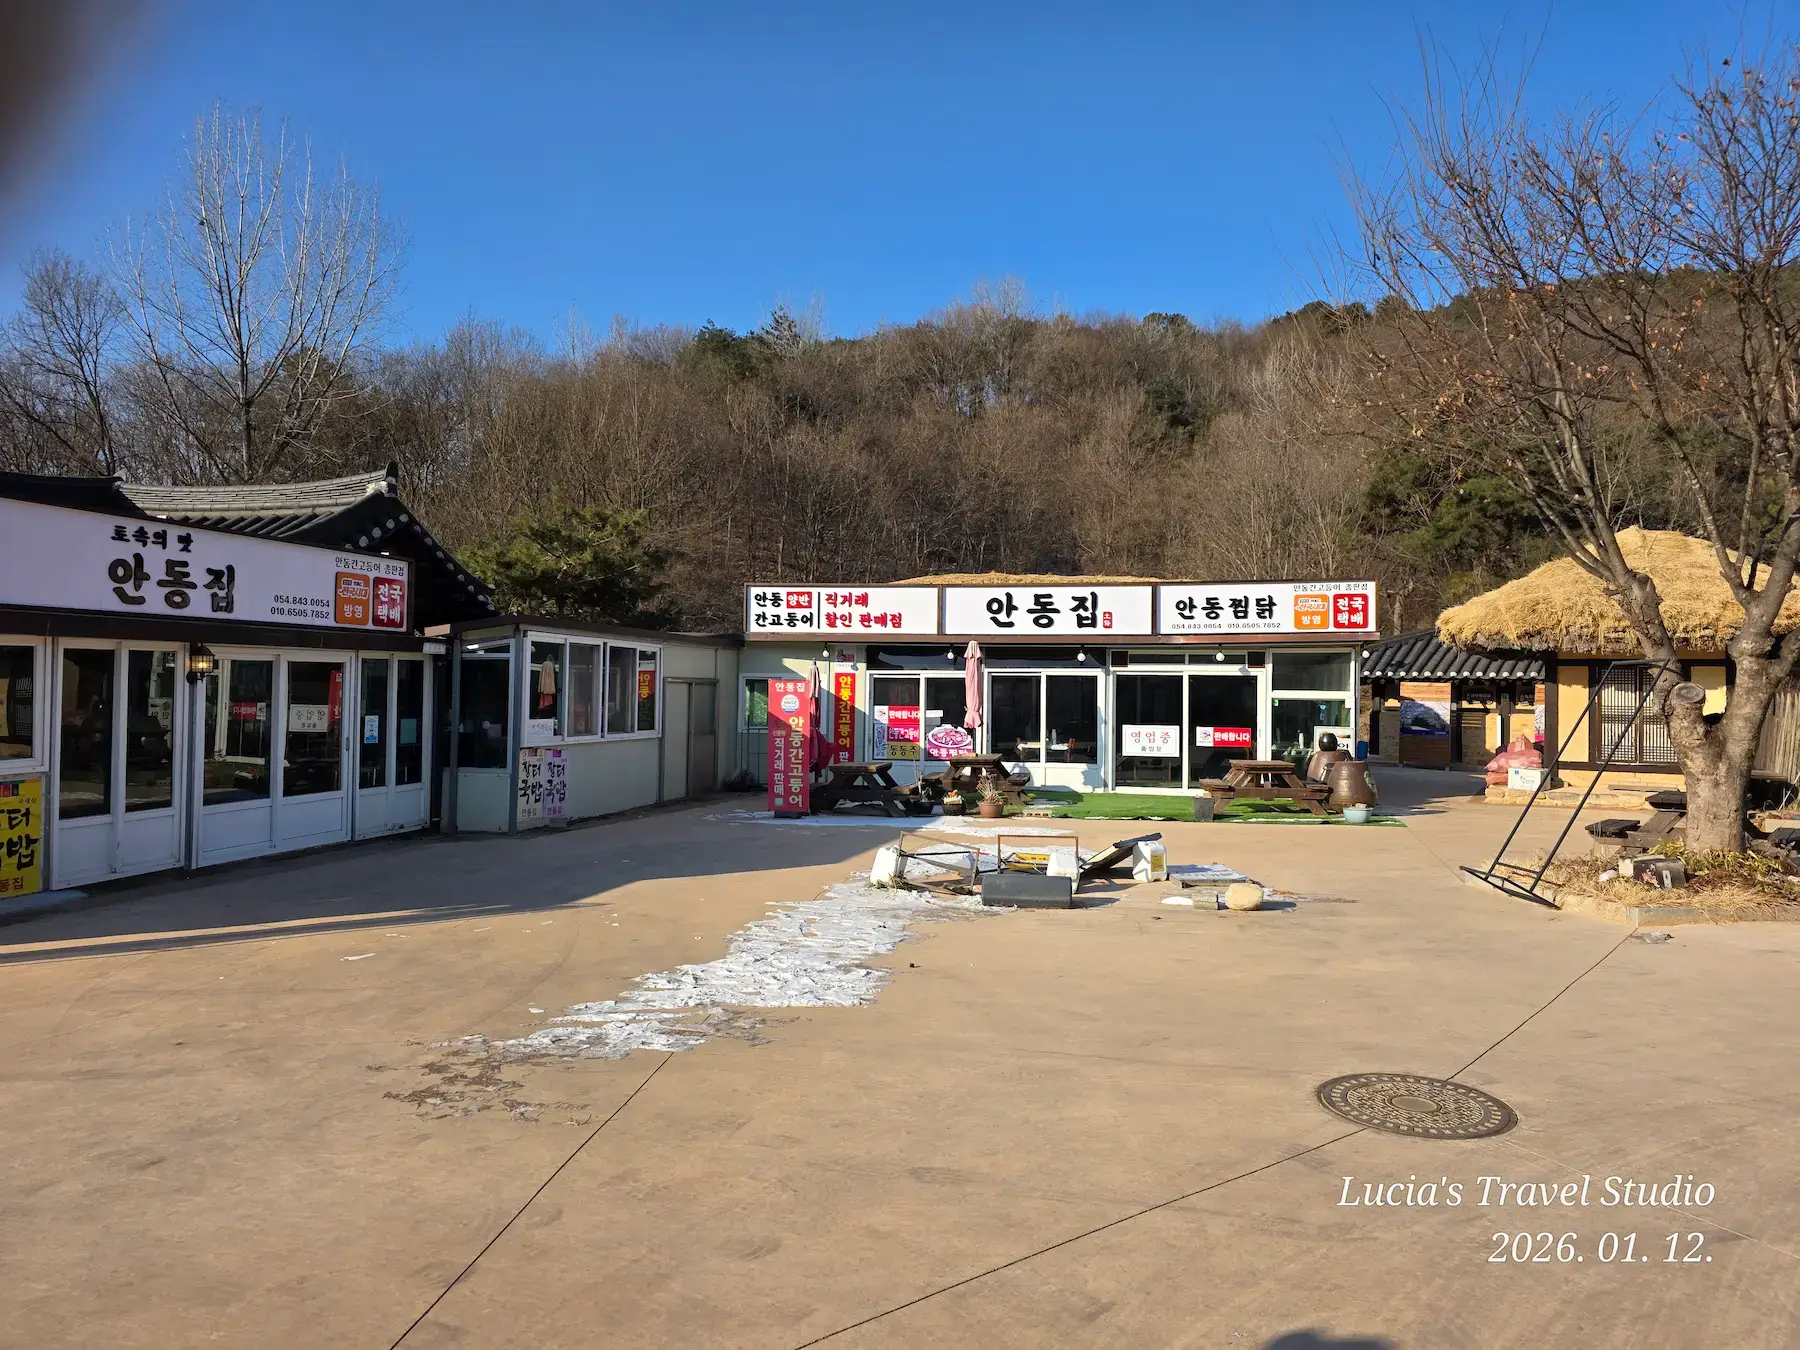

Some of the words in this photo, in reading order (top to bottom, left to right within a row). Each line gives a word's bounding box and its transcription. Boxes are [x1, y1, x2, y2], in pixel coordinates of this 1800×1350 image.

[111, 525, 167, 550] 토속의
[177, 533, 193, 552] 맛
[335, 556, 380, 573] 안동간고등어
[384, 564, 405, 577] 총판점
[108, 552, 235, 613] 안동집
[1293, 584, 1341, 592] 안동간고등어
[1345, 583, 1368, 591] 총판점
[273, 594, 330, 608] 054.843.0054
[378, 583, 403, 602] 전국
[754, 591, 784, 608] 안동
[787, 594, 811, 607] 양반
[825, 592, 869, 608] 직거래
[344, 604, 363, 618] 방영
[986, 591, 1099, 629] 안동집
[1175, 595, 1278, 620] 안동찜닭
[1336, 597, 1365, 610] 전국
[270, 606, 330, 619] 010.6505.7852
[378, 603, 401, 623] 택배
[754, 612, 814, 628] 간고등어
[825, 612, 853, 629] 할인
[859, 612, 903, 629] 판매점
[1301, 615, 1321, 625] 방영
[1336, 611, 1364, 626] 택배
[775, 682, 805, 692] 안동집
[839, 675, 853, 748] 안동간고등어
[889, 728, 918, 740] 안동간고등어
[1131, 731, 1171, 744] 영업중
[1214, 732, 1250, 741] 판매합니다
[522, 761, 542, 779] 장터
[547, 761, 565, 779] 장터
[788, 716, 804, 808] 안동간고등어
[519, 779, 543, 805] 국밥
[545, 779, 567, 804] 국밥
[0, 807, 31, 830] 터
[0, 833, 39, 872] 밥
